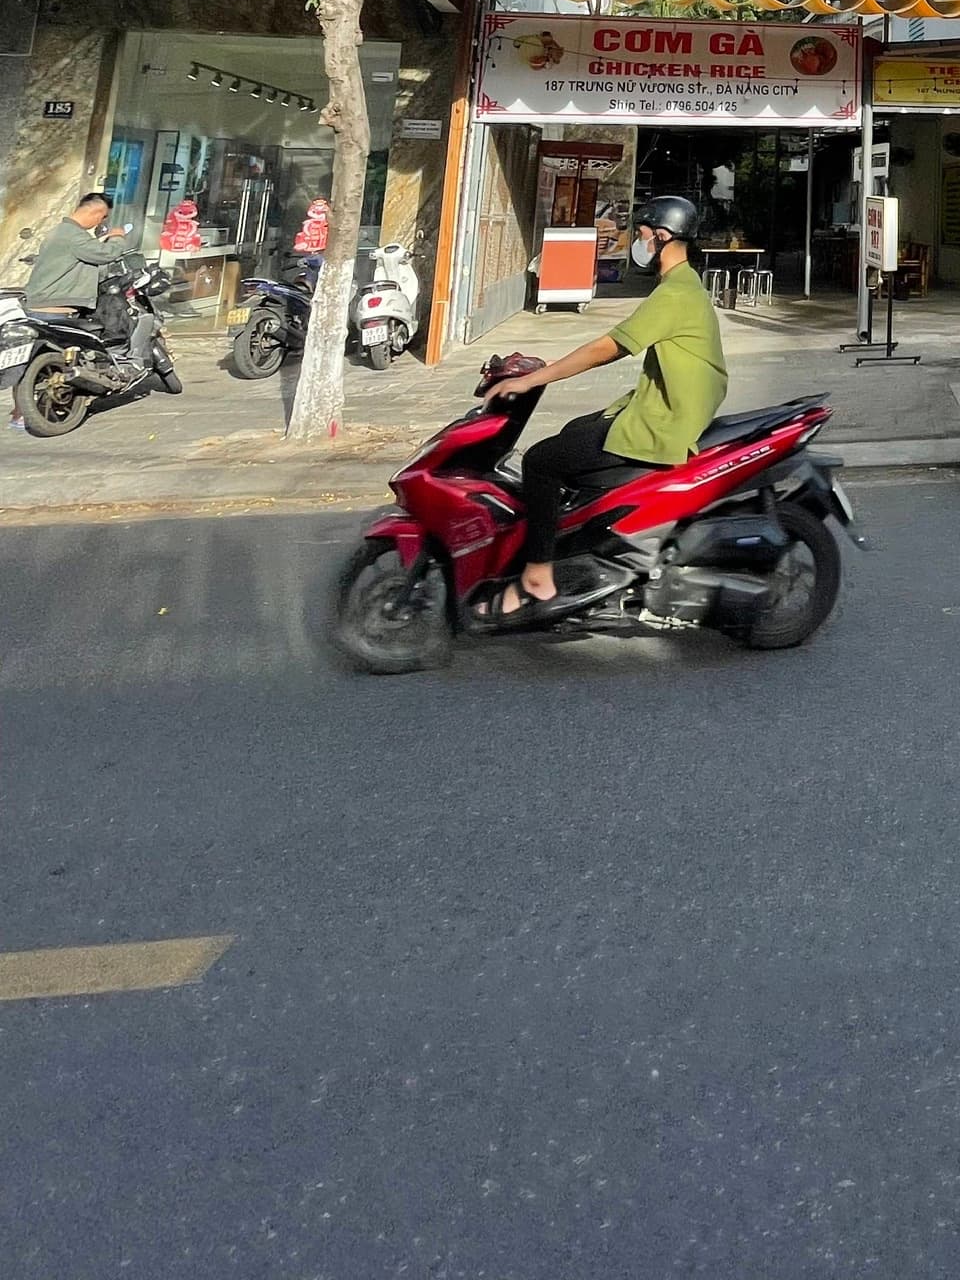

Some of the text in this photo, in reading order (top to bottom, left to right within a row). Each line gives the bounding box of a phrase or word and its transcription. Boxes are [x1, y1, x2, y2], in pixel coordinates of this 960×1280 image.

[593, 28, 766, 57] CƠM GÀ
[588, 60, 767, 79] CHICKEN RICE
[544, 81, 565, 92] 187
[567, 80, 613, 93] TRƯNG
[616, 78, 638, 93] NỮ
[639, 82, 684, 95] VƯƠNG
[716, 81, 733, 95] ĐÀ
[772, 85, 798, 96] CITY
[48, 102, 71, 113] 185
[609, 99, 635, 112] Ship
